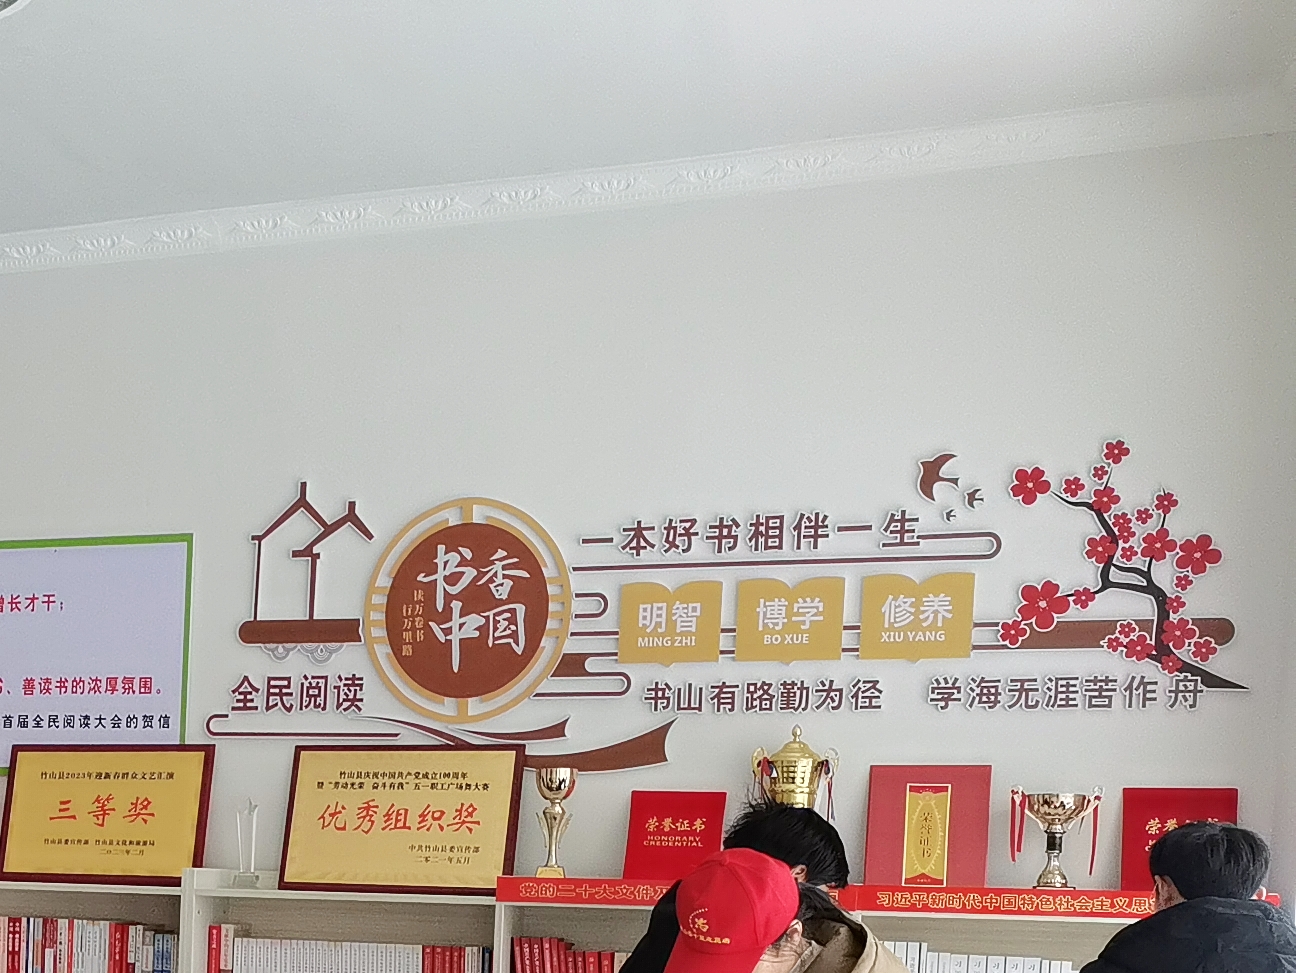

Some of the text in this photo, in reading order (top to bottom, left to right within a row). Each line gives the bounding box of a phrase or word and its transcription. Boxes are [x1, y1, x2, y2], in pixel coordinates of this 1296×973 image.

[581, 510, 920, 557] 一本好书相伴一生
[416, 544, 531, 613] 书香
[638, 601, 702, 634] 明智
[756, 597, 824, 631] 博学
[882, 593, 954, 629] 修养
[402, 604, 413, 656] 行万里路
[429, 600, 526, 673] 中国
[637, 635, 696, 648] MING ZHI
[763, 633, 810, 645] BO XUE
[880, 630, 946, 643] XIU YANG
[230, 673, 365, 713] 全民阅读
[644, 678, 884, 713] 书山有路勤为径
[929, 674, 1204, 710] 学海无涯苦作舟
[48, 793, 156, 828] 三等奖
[317, 798, 482, 835] 优秀组织奖
[644, 817, 707, 833] 荣誉证书
[876, 890, 1156, 914] 习近平新时代中国特色社会主义思
